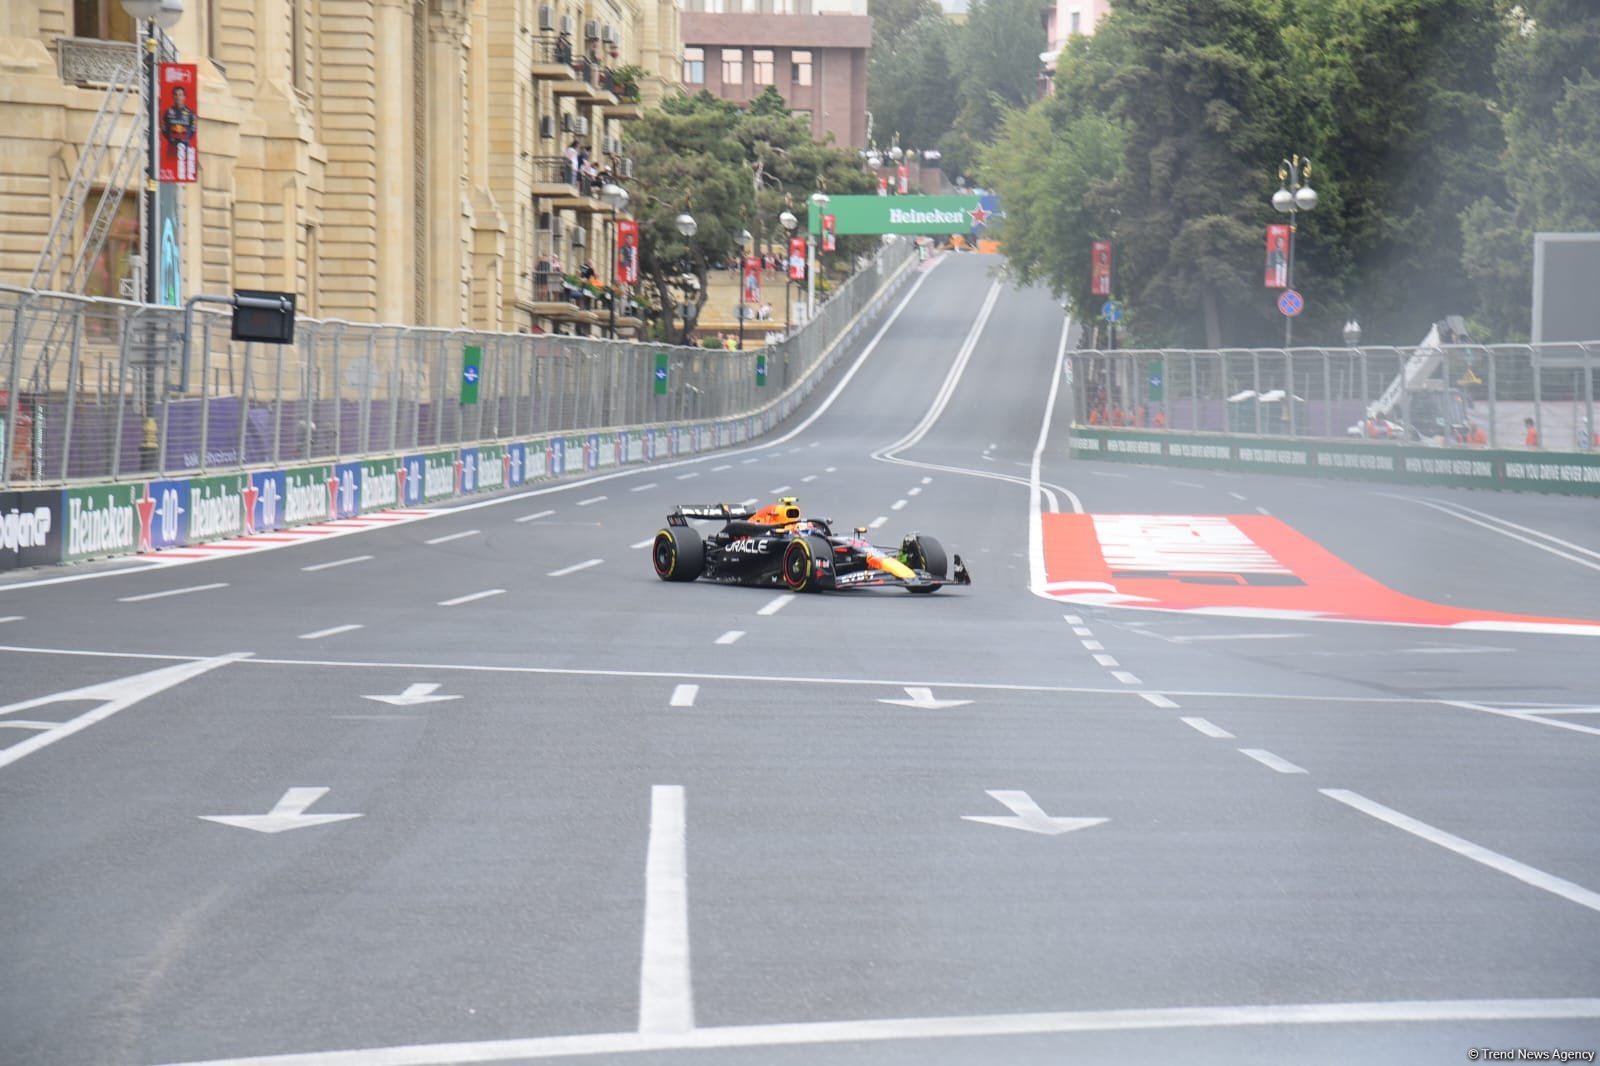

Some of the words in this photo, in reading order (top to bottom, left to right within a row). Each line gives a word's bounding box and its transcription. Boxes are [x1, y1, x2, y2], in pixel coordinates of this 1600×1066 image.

[889, 208, 964, 224] Heineken
[1583, 466, 1600, 483] DRIN
[189, 484, 240, 538] Heineken
[285, 474, 326, 522] Heineken
[69, 494, 133, 554] Heineken
[725, 539, 770, 554] ORACLE
